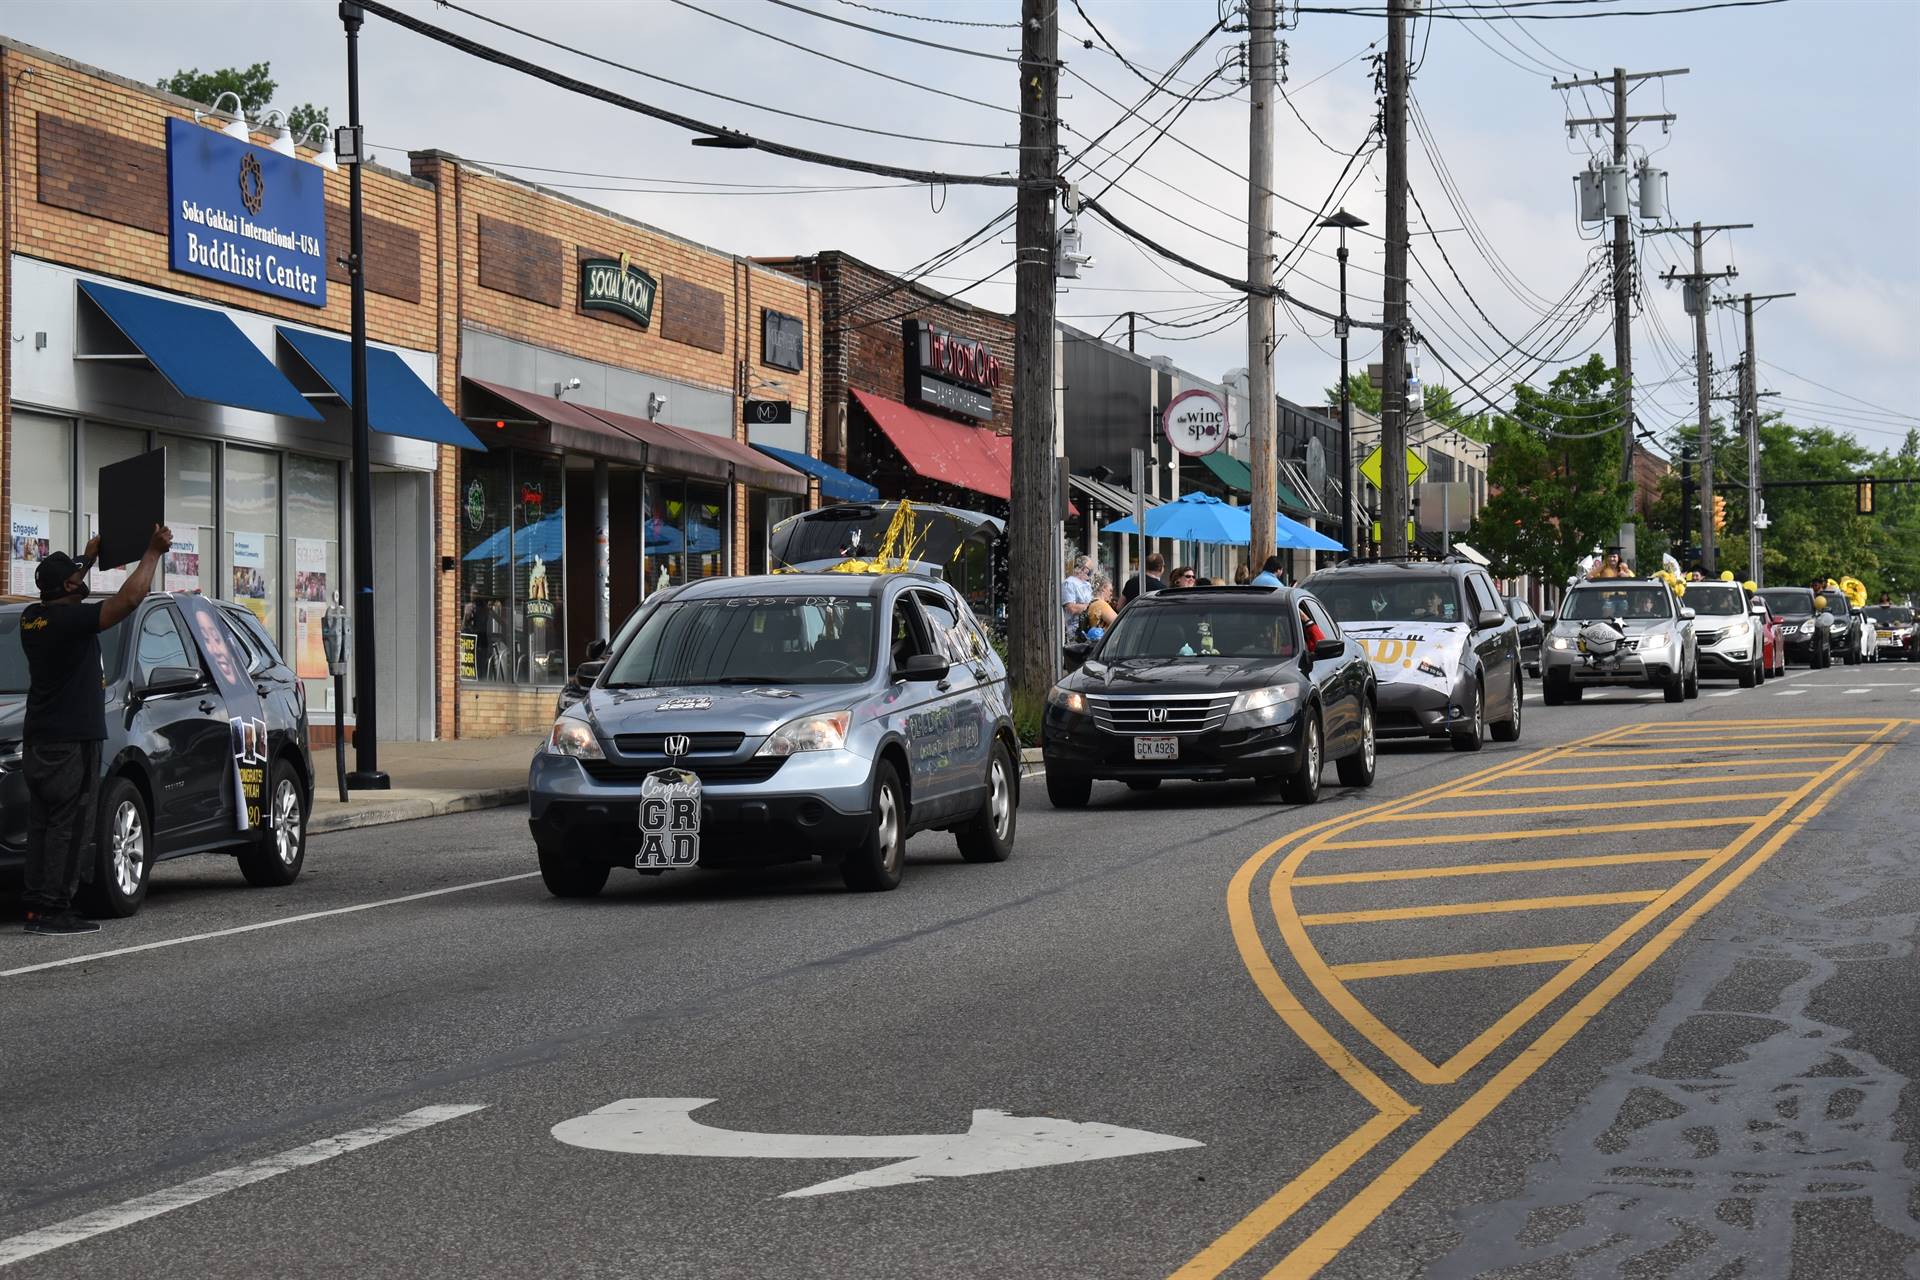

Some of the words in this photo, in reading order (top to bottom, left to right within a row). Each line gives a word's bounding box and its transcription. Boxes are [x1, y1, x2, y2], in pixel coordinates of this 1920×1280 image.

[182, 200, 205, 225] Soka
[206, 207, 238, 234] Gakkai
[187, 232, 261, 280] Buddhist
[265, 255, 317, 294] Center
[590, 269, 620, 298] SOCIAL
[622, 275, 650, 312] ROOM
[1177, 415, 1187, 424] the
[1187, 407, 1223, 423] wine
[1188, 423, 1221, 441] spot
[12, 521, 39, 537] Engaged
[1137, 742, 1152, 754] GCK
[1154, 742, 1175, 754] 4926
[641, 775, 699, 802] Congrats
